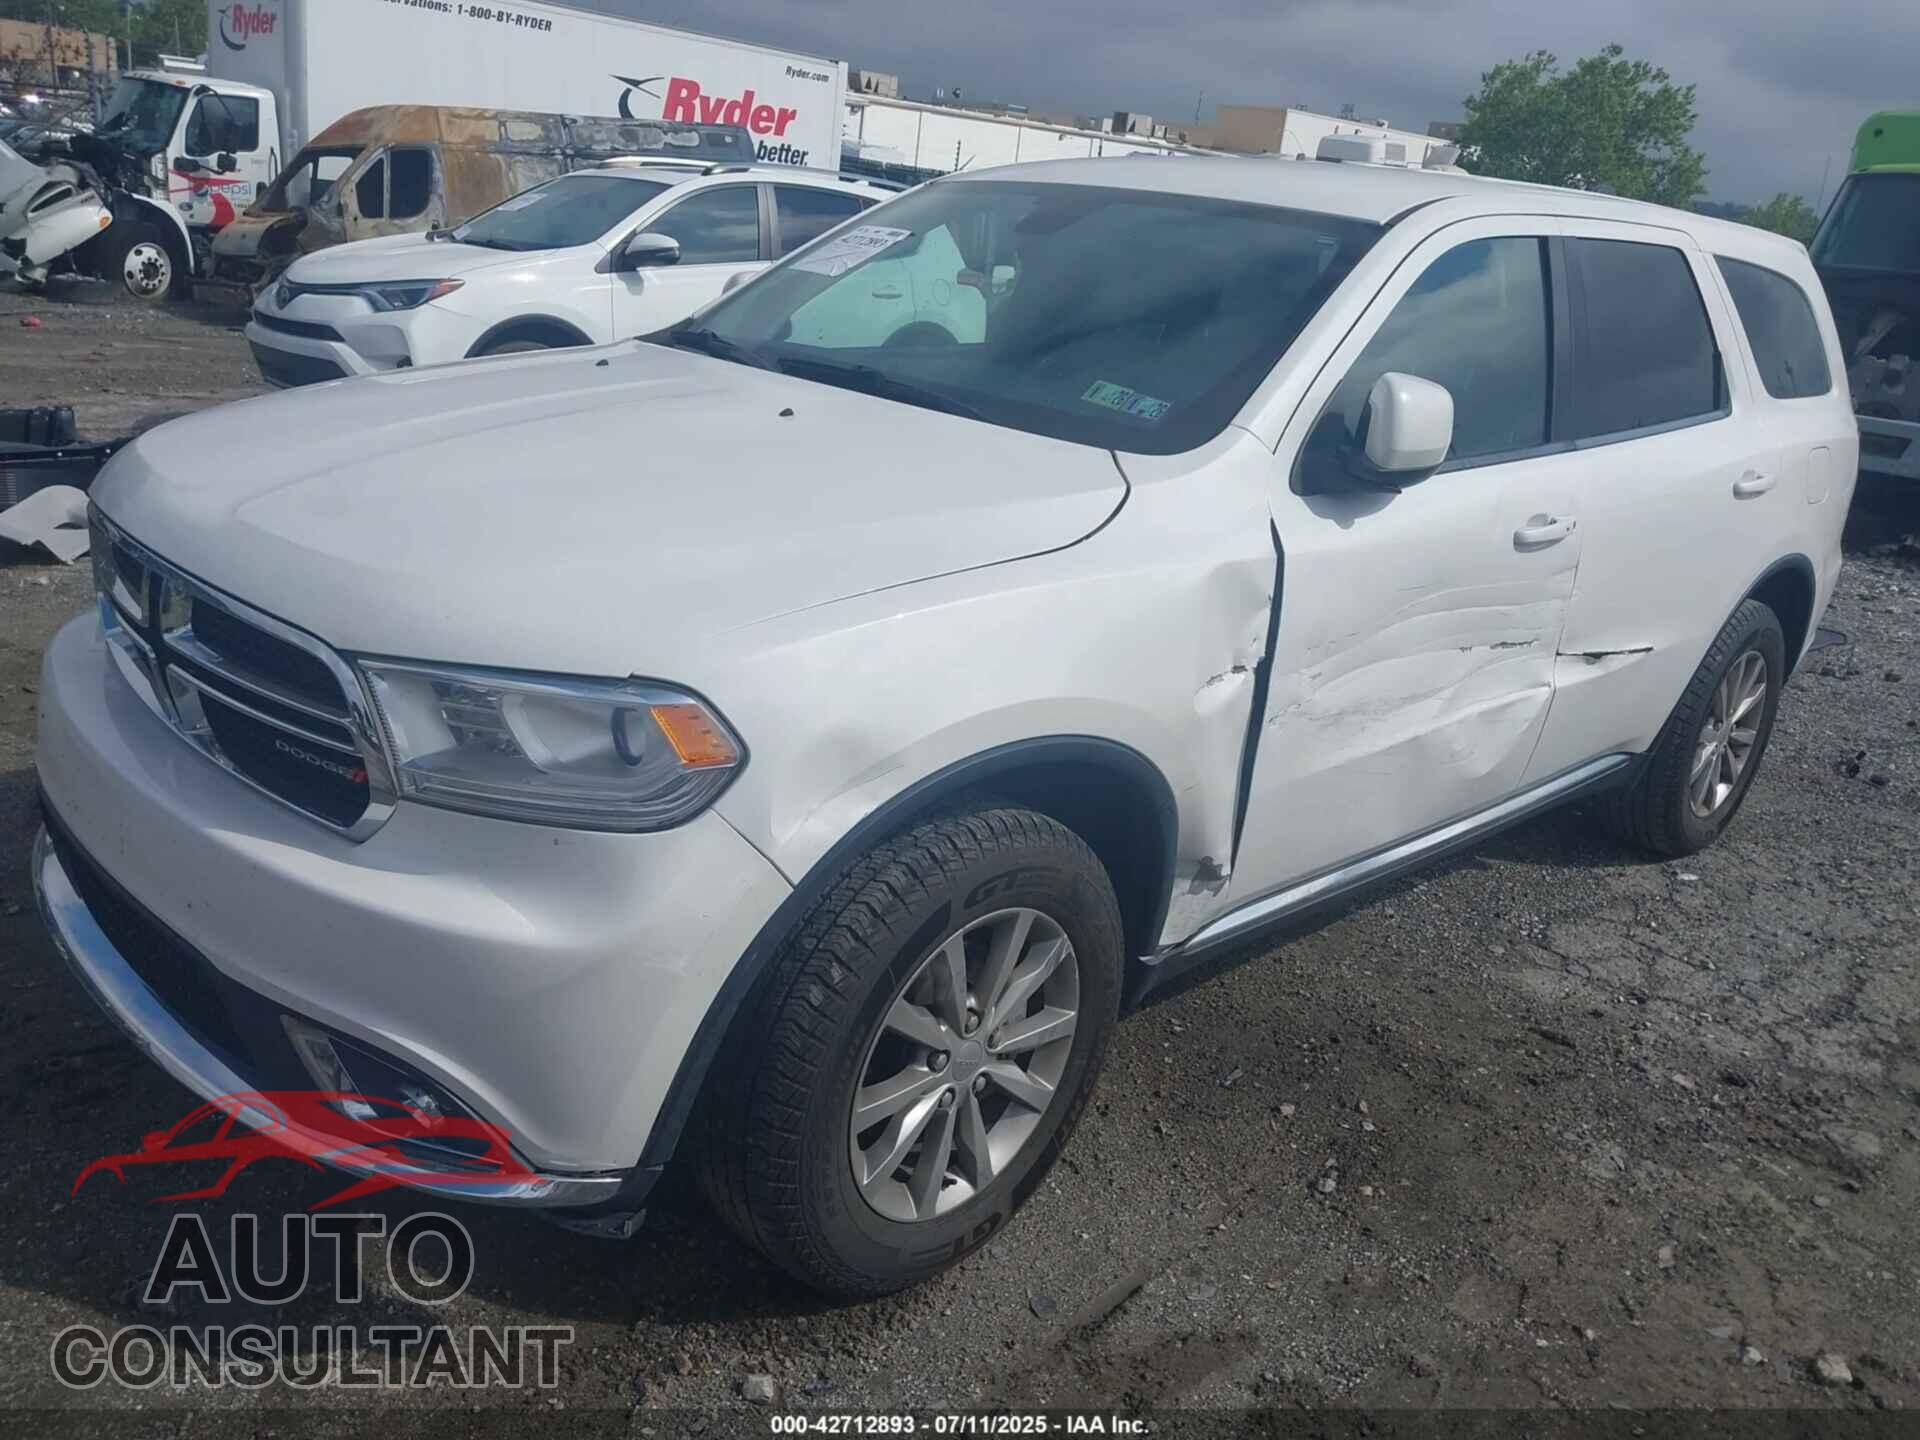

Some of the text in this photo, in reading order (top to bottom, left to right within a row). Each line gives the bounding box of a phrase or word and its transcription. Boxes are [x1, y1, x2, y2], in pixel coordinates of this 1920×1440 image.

[232, 4, 277, 41] Ryder
[457, 4, 552, 32] 1-800-BY-RYDER
[786, 65, 829, 83] Ryder.com
[662, 77, 797, 136] Ryder
[756, 140, 808, 167] better.
